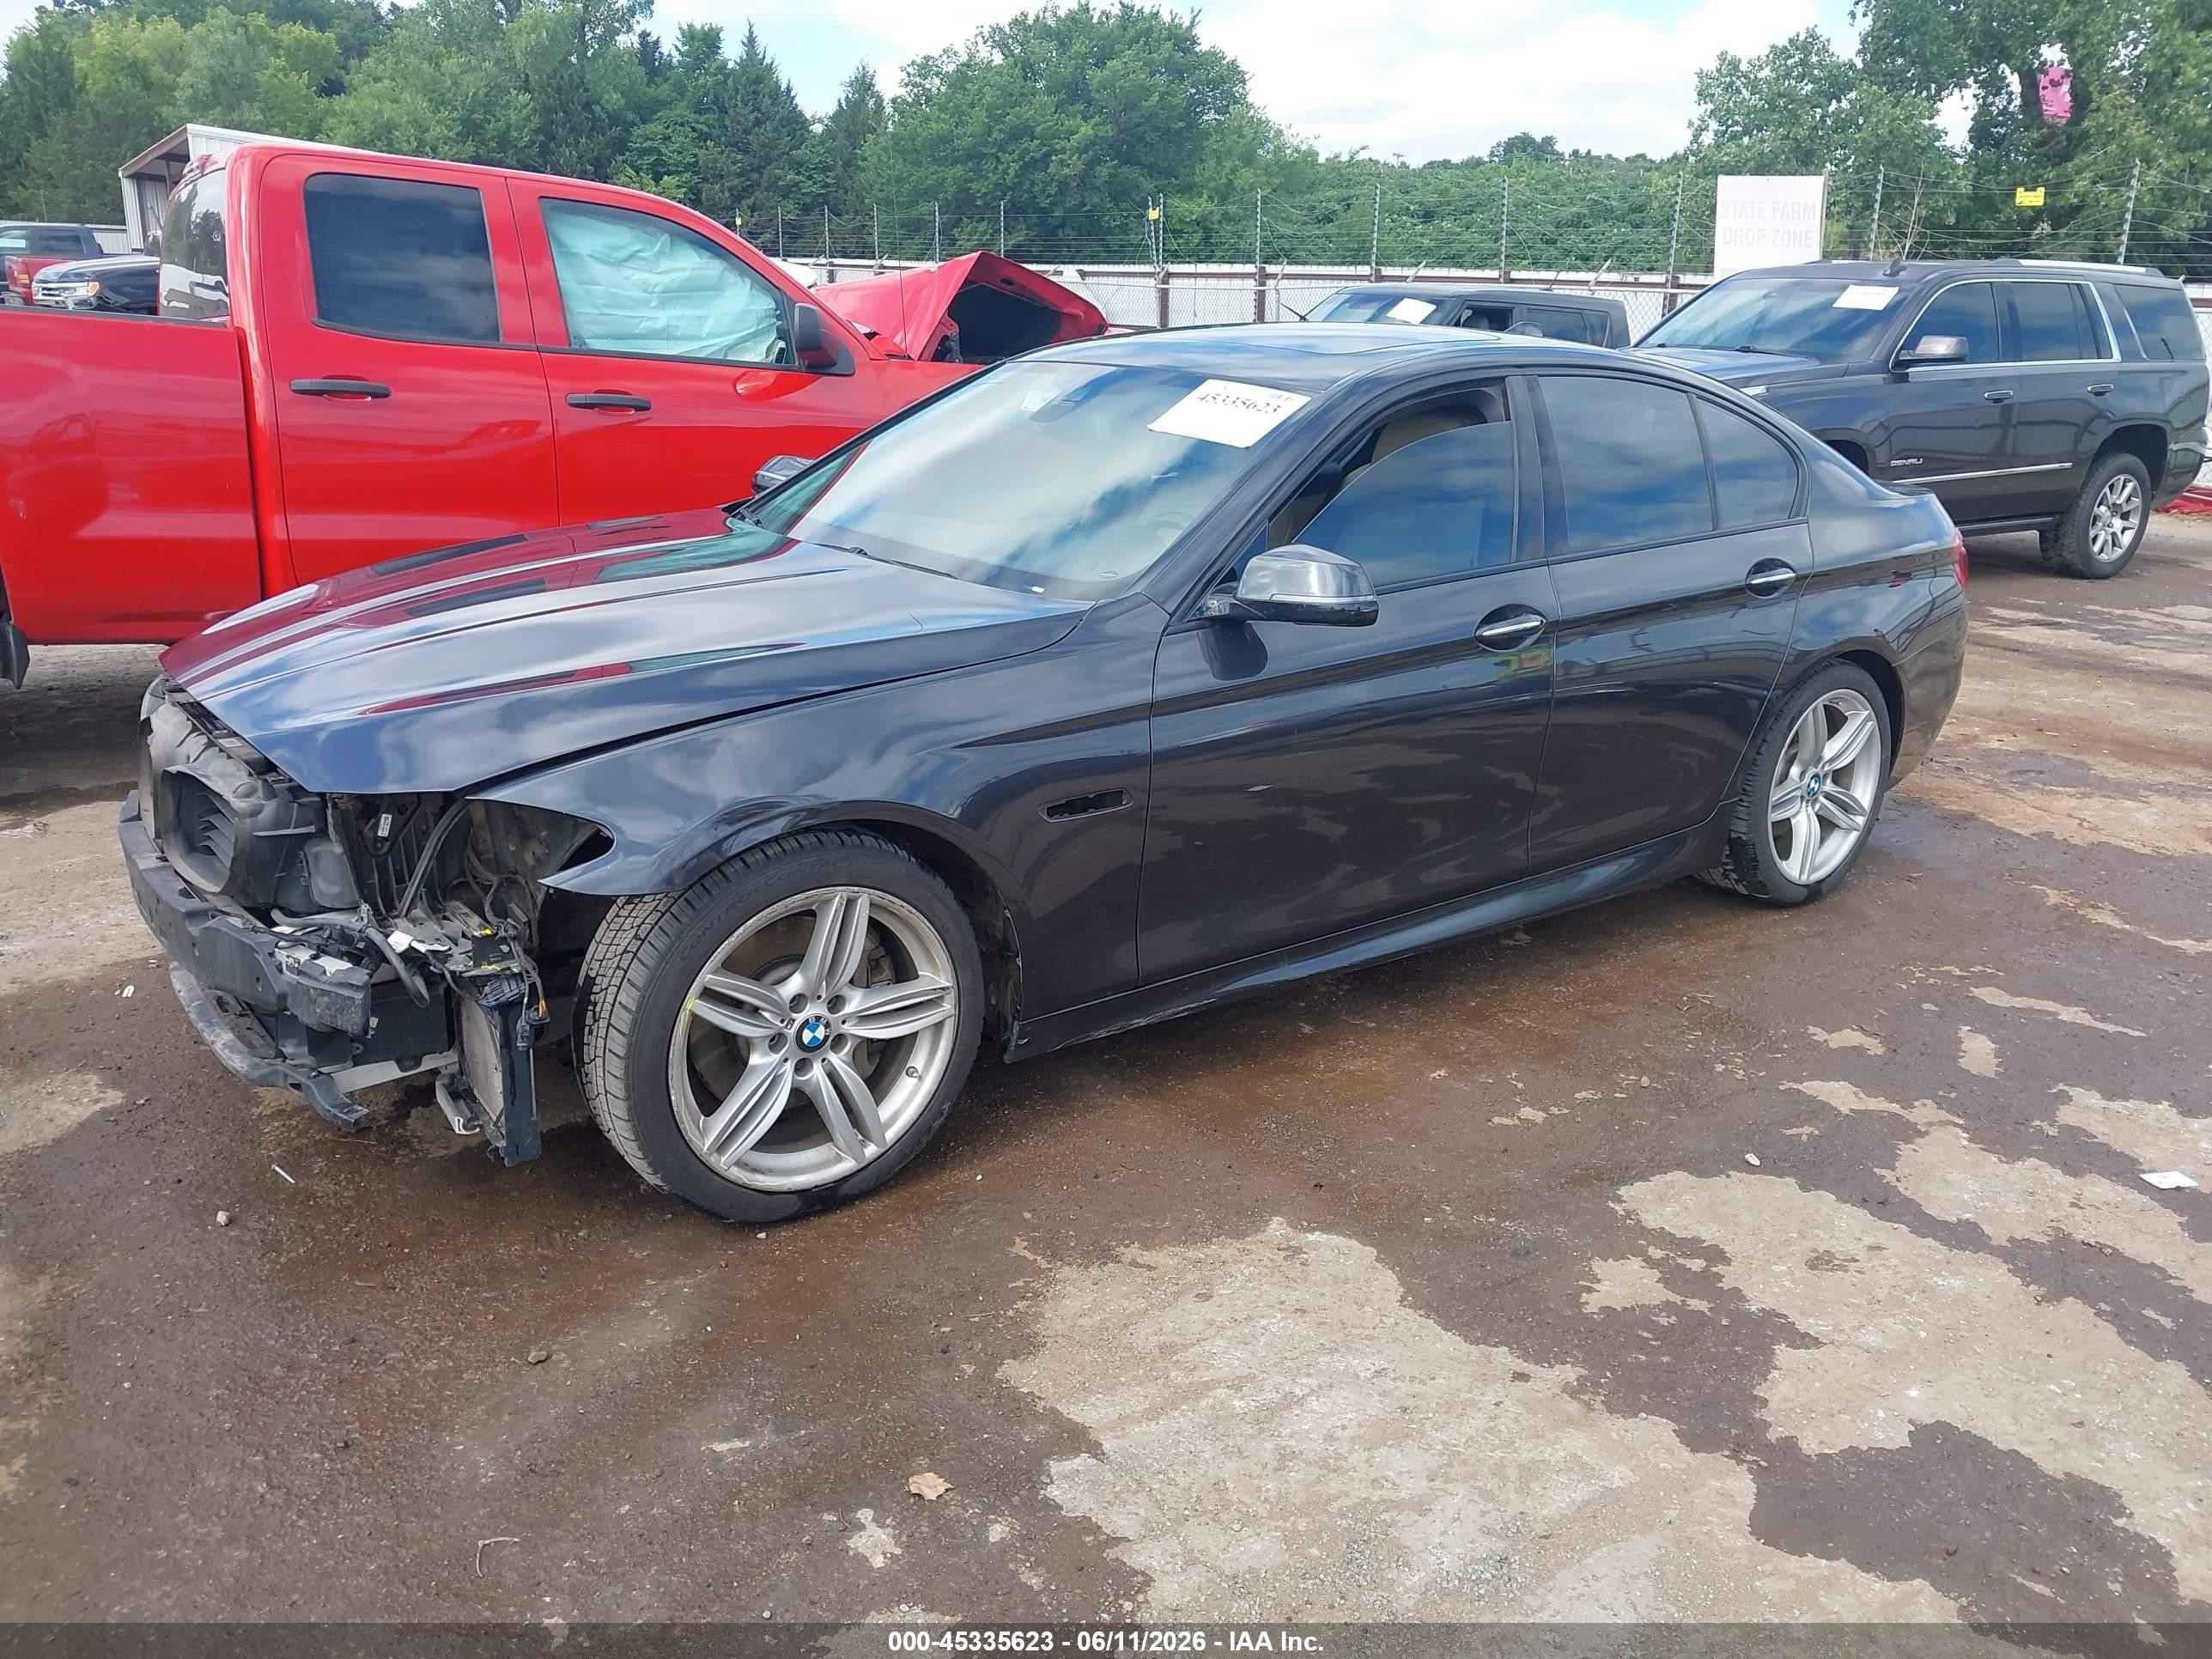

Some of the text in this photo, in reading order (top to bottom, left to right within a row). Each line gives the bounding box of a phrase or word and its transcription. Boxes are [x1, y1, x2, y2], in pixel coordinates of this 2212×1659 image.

[1722, 200, 1816, 221] STATE FARM
[1723, 228, 1814, 248] DROP ZONE
[1890, 458, 1923, 467] DENALI
